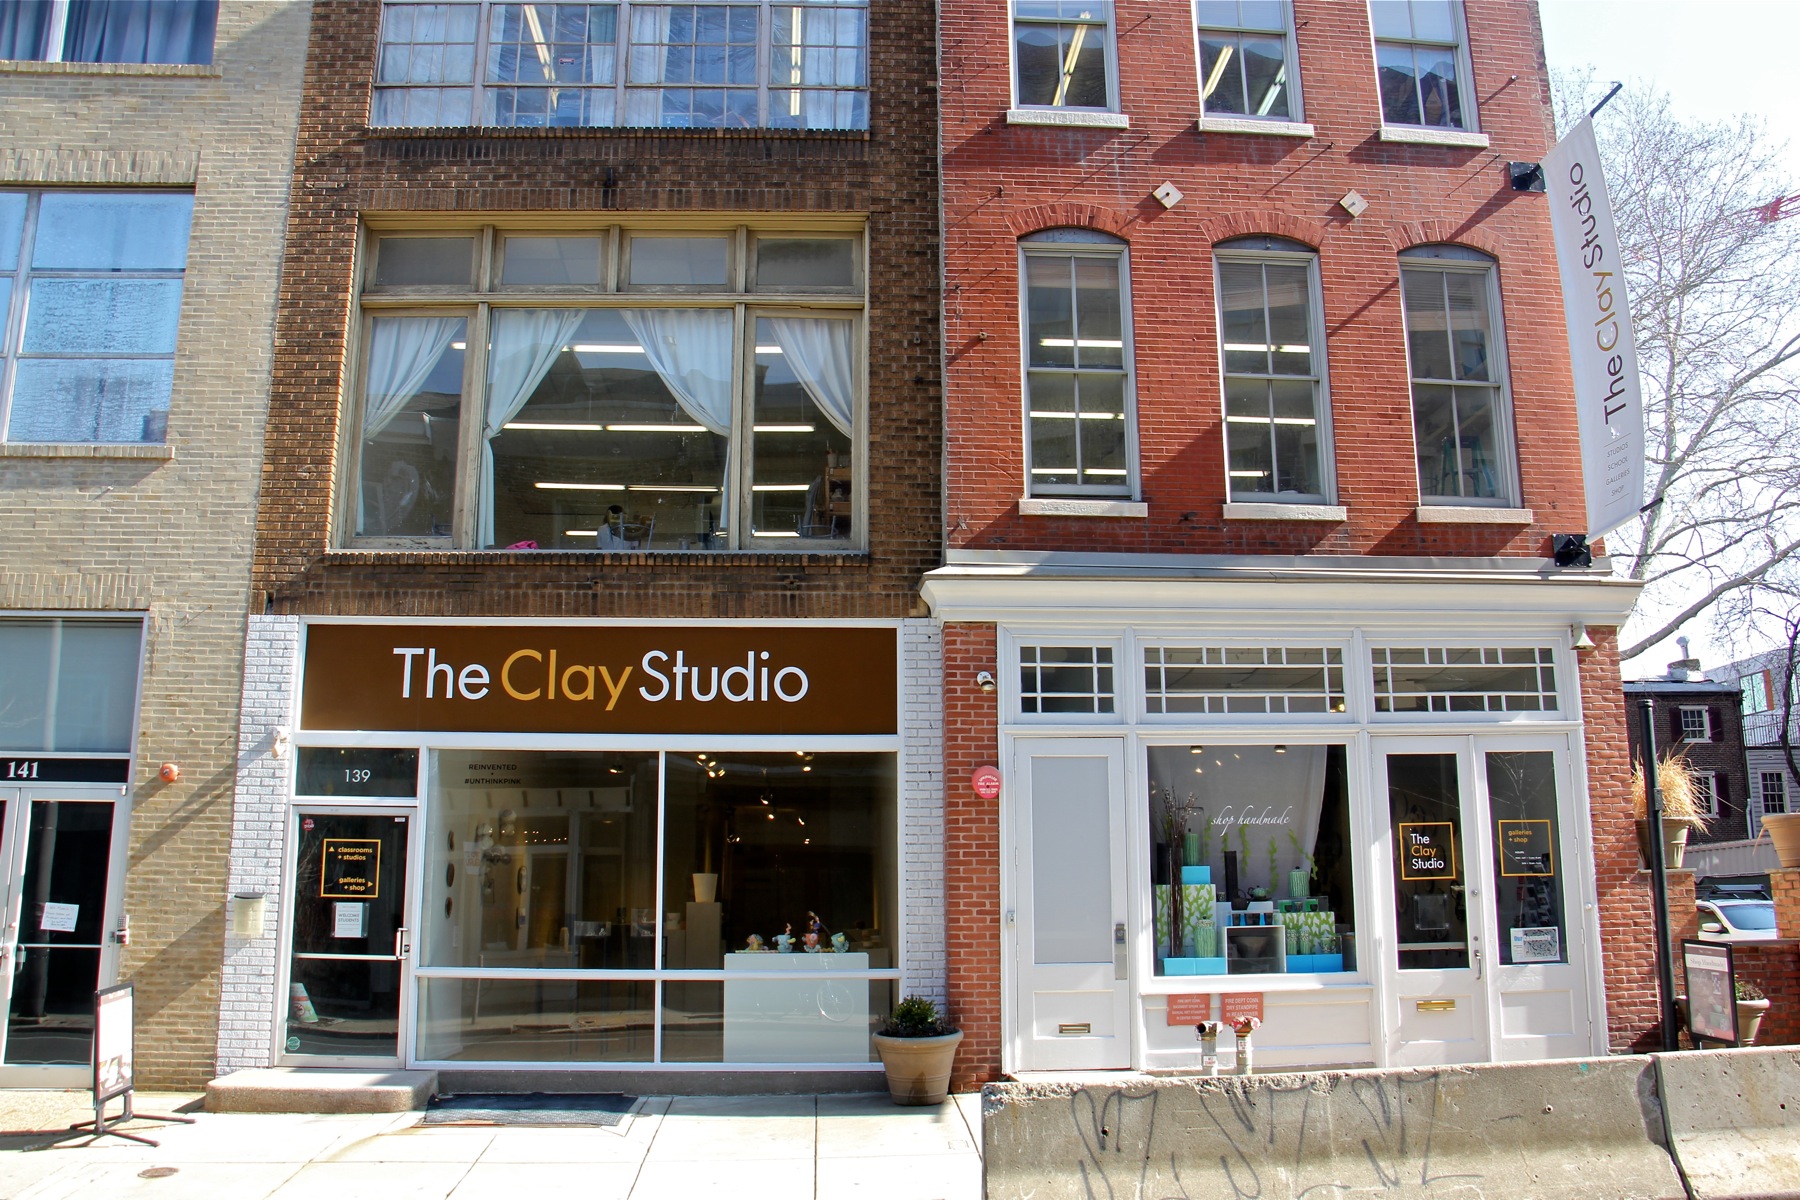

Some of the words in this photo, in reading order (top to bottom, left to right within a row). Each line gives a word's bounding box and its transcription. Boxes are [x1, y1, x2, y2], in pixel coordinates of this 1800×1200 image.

[1570, 162, 1603, 269] Studio
[1593, 272, 1619, 352] Clay
[1604, 353, 1627, 425] The
[1607, 442, 1629, 458] STUDIOS
[1607, 456, 1629, 471] SCHOOL
[1605, 468, 1631, 486] GALLERIES
[1611, 484, 1625, 497] SHOP
[393, 647, 490, 700] The
[501, 648, 633, 711] Clay
[638, 650, 809, 702] Studio
[7, 761, 39, 778] 141
[345, 769, 371, 783] 139
[1211, 805, 1234, 837] shop
[1237, 805, 1293, 825] handmade
[1410, 833, 1430, 844] The
[1411, 845, 1436, 857] Clay
[1412, 858, 1444, 869] Studio
